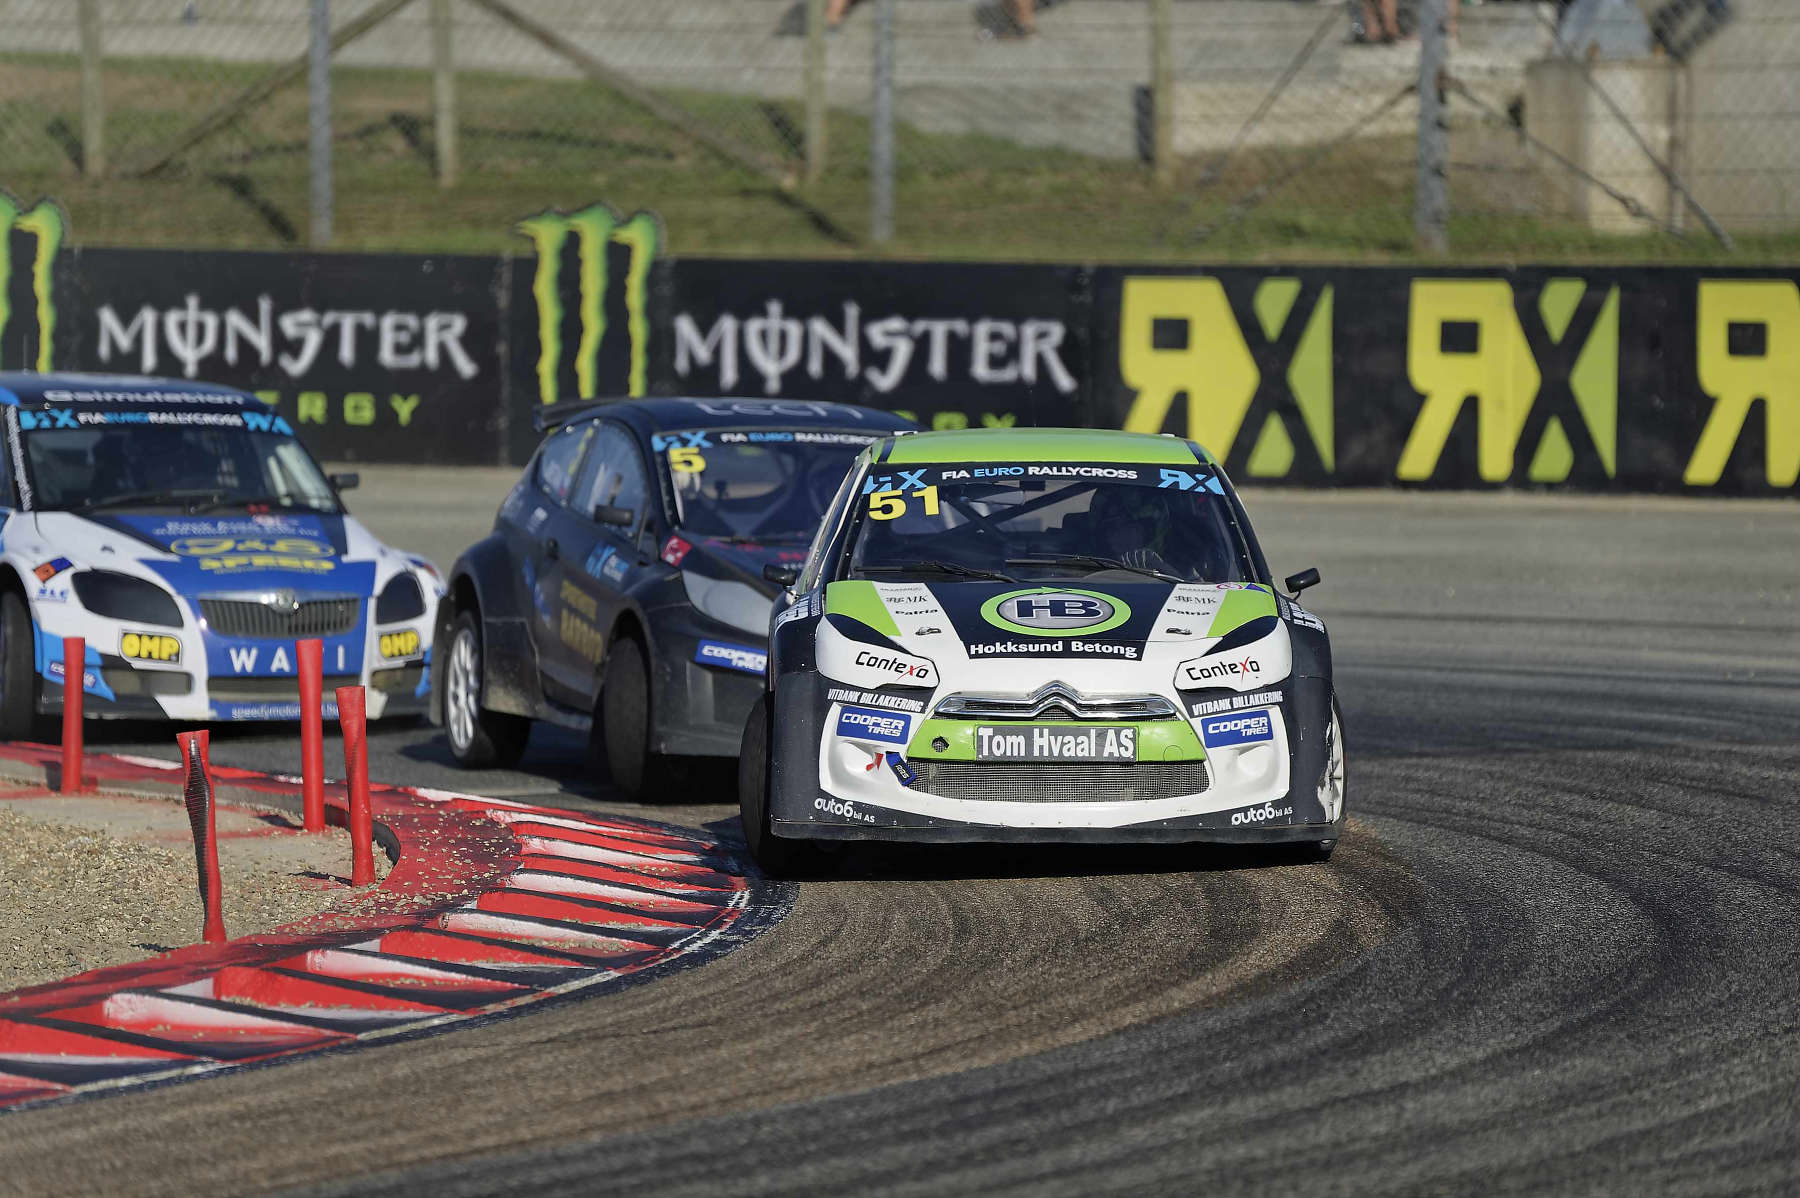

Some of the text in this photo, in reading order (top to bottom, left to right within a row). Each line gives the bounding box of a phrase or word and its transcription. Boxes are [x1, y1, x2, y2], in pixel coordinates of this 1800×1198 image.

[97, 293, 479, 379] MONSTER
[673, 298, 1078, 394] MONSTER
[720, 433, 748, 443] FIA
[749, 432, 793, 442] EURO
[669, 447, 706, 473] 5
[942, 471, 970, 481] FIA
[974, 466, 1024, 478] EURO
[1028, 466, 1138, 480] RALLYCROSS
[868, 485, 940, 521] 51
[1015, 599, 1104, 620] HB
[122, 633, 179, 661] OMP
[379, 630, 420, 658] OMP
[970, 640, 1138, 659] Hokksund Betong
[229, 644, 345, 673] WAI
[859, 691, 924, 712] BILLAKKERING
[1232, 690, 1283, 709] BILLAKKERING
[841, 713, 906, 730] COOPER
[867, 725, 903, 737] TIRES
[1208, 716, 1269, 734] COOPER
[1240, 726, 1269, 737] TIRES
[978, 727, 1134, 758] Tom Hvaal AS
[864, 814, 876, 823] AS
[1284, 806, 1293, 815] AS
